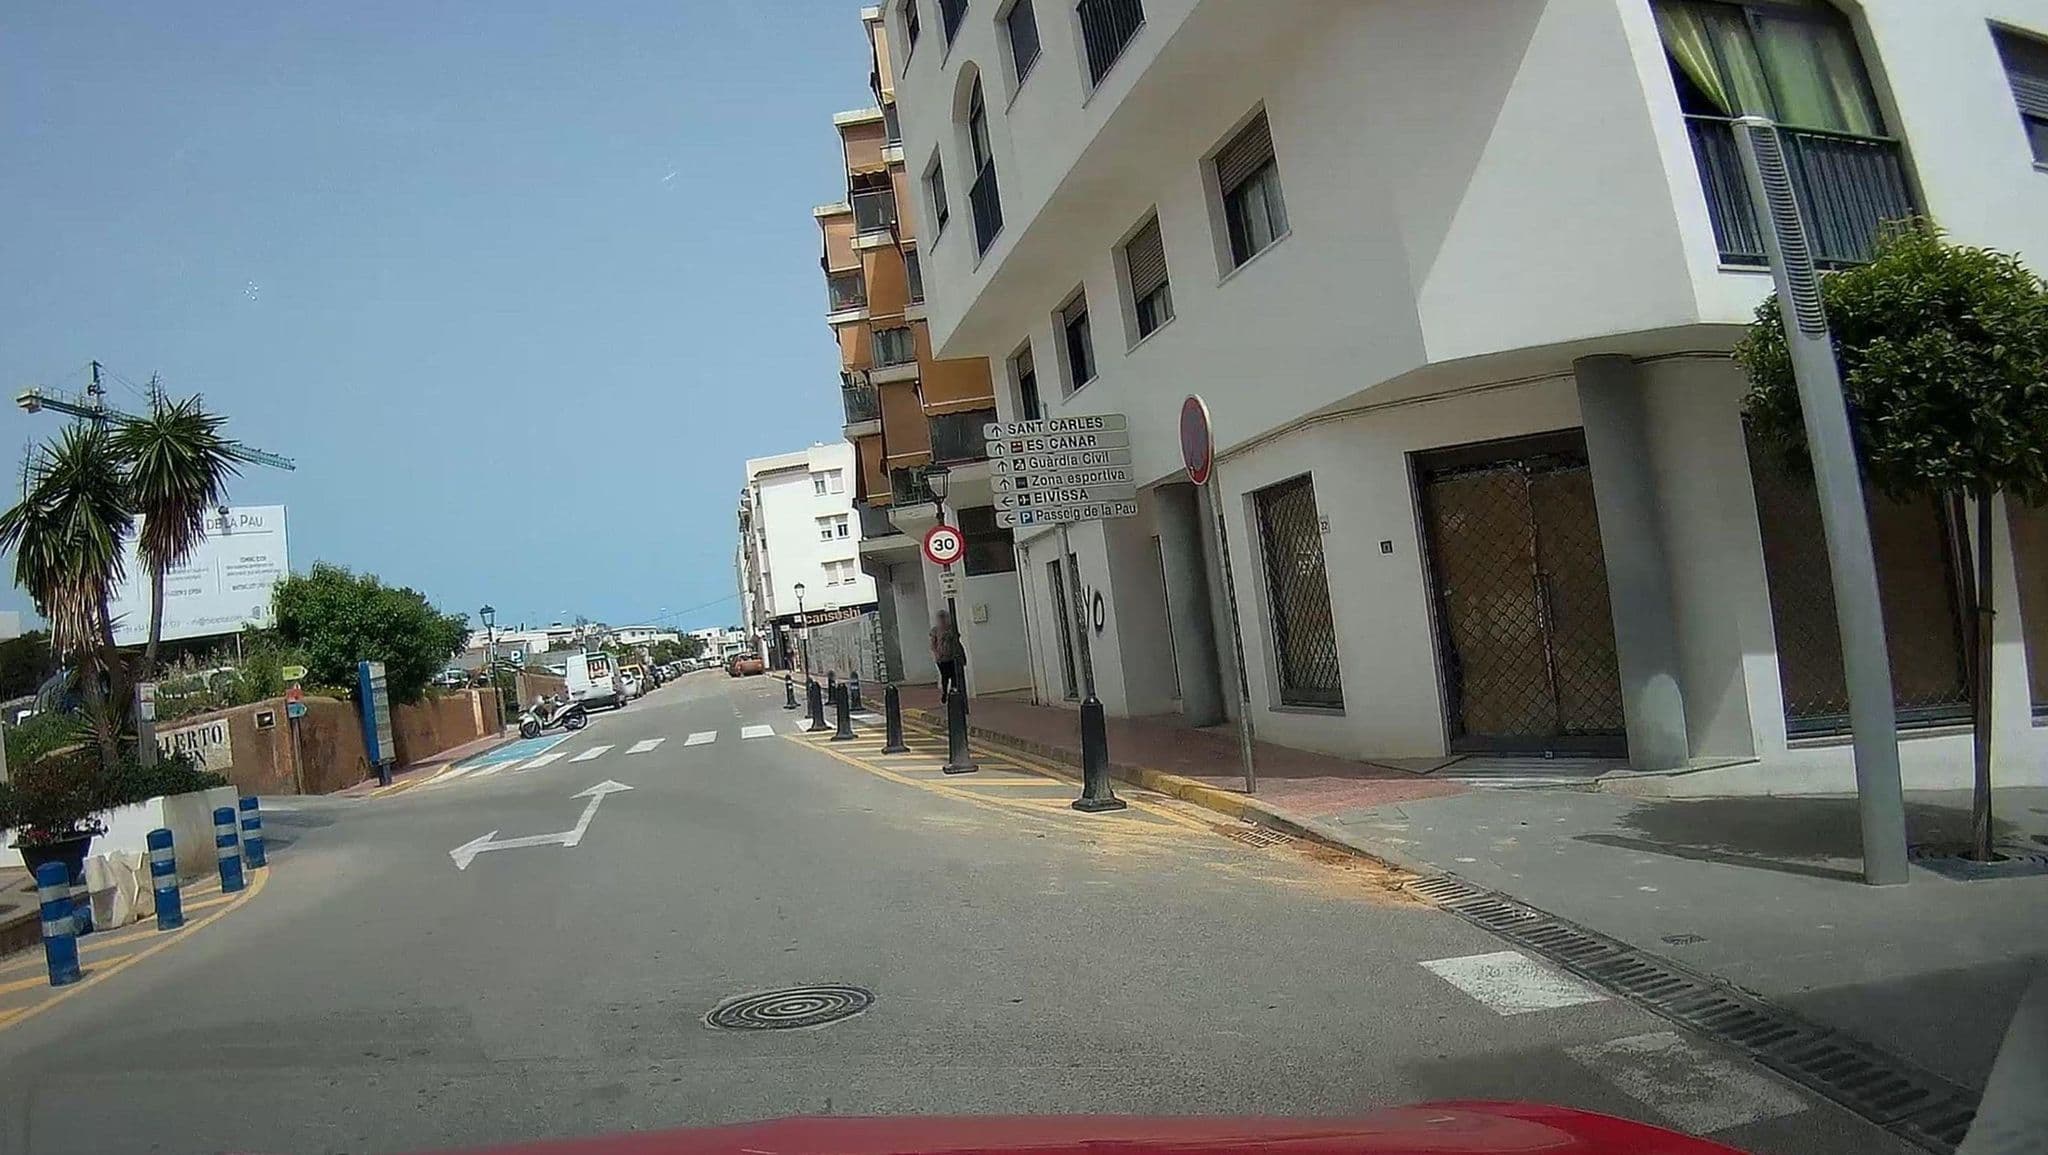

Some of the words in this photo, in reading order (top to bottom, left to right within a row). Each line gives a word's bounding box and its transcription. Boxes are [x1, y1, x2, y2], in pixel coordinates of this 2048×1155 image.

[1007, 421, 1043, 435] SANT
[1050, 417, 1103, 431] CARLES
[1027, 439, 1044, 451] ES
[1050, 435, 1097, 449] CANAR
[1029, 455, 1078, 469] Guàrdia
[1083, 451, 1109, 465] Civil
[1032, 474, 1063, 486] Zona
[1067, 469, 1126, 485] esportiva
[1034, 489, 1089, 503] EIVISSA
[1036, 507, 1080, 521] Passeig
[1084, 505, 1098, 517] de
[1101, 504, 1113, 516] la
[1115, 503, 1137, 514] Pau
[933, 538, 955, 552] 30
[511, 650, 521, 661] P
